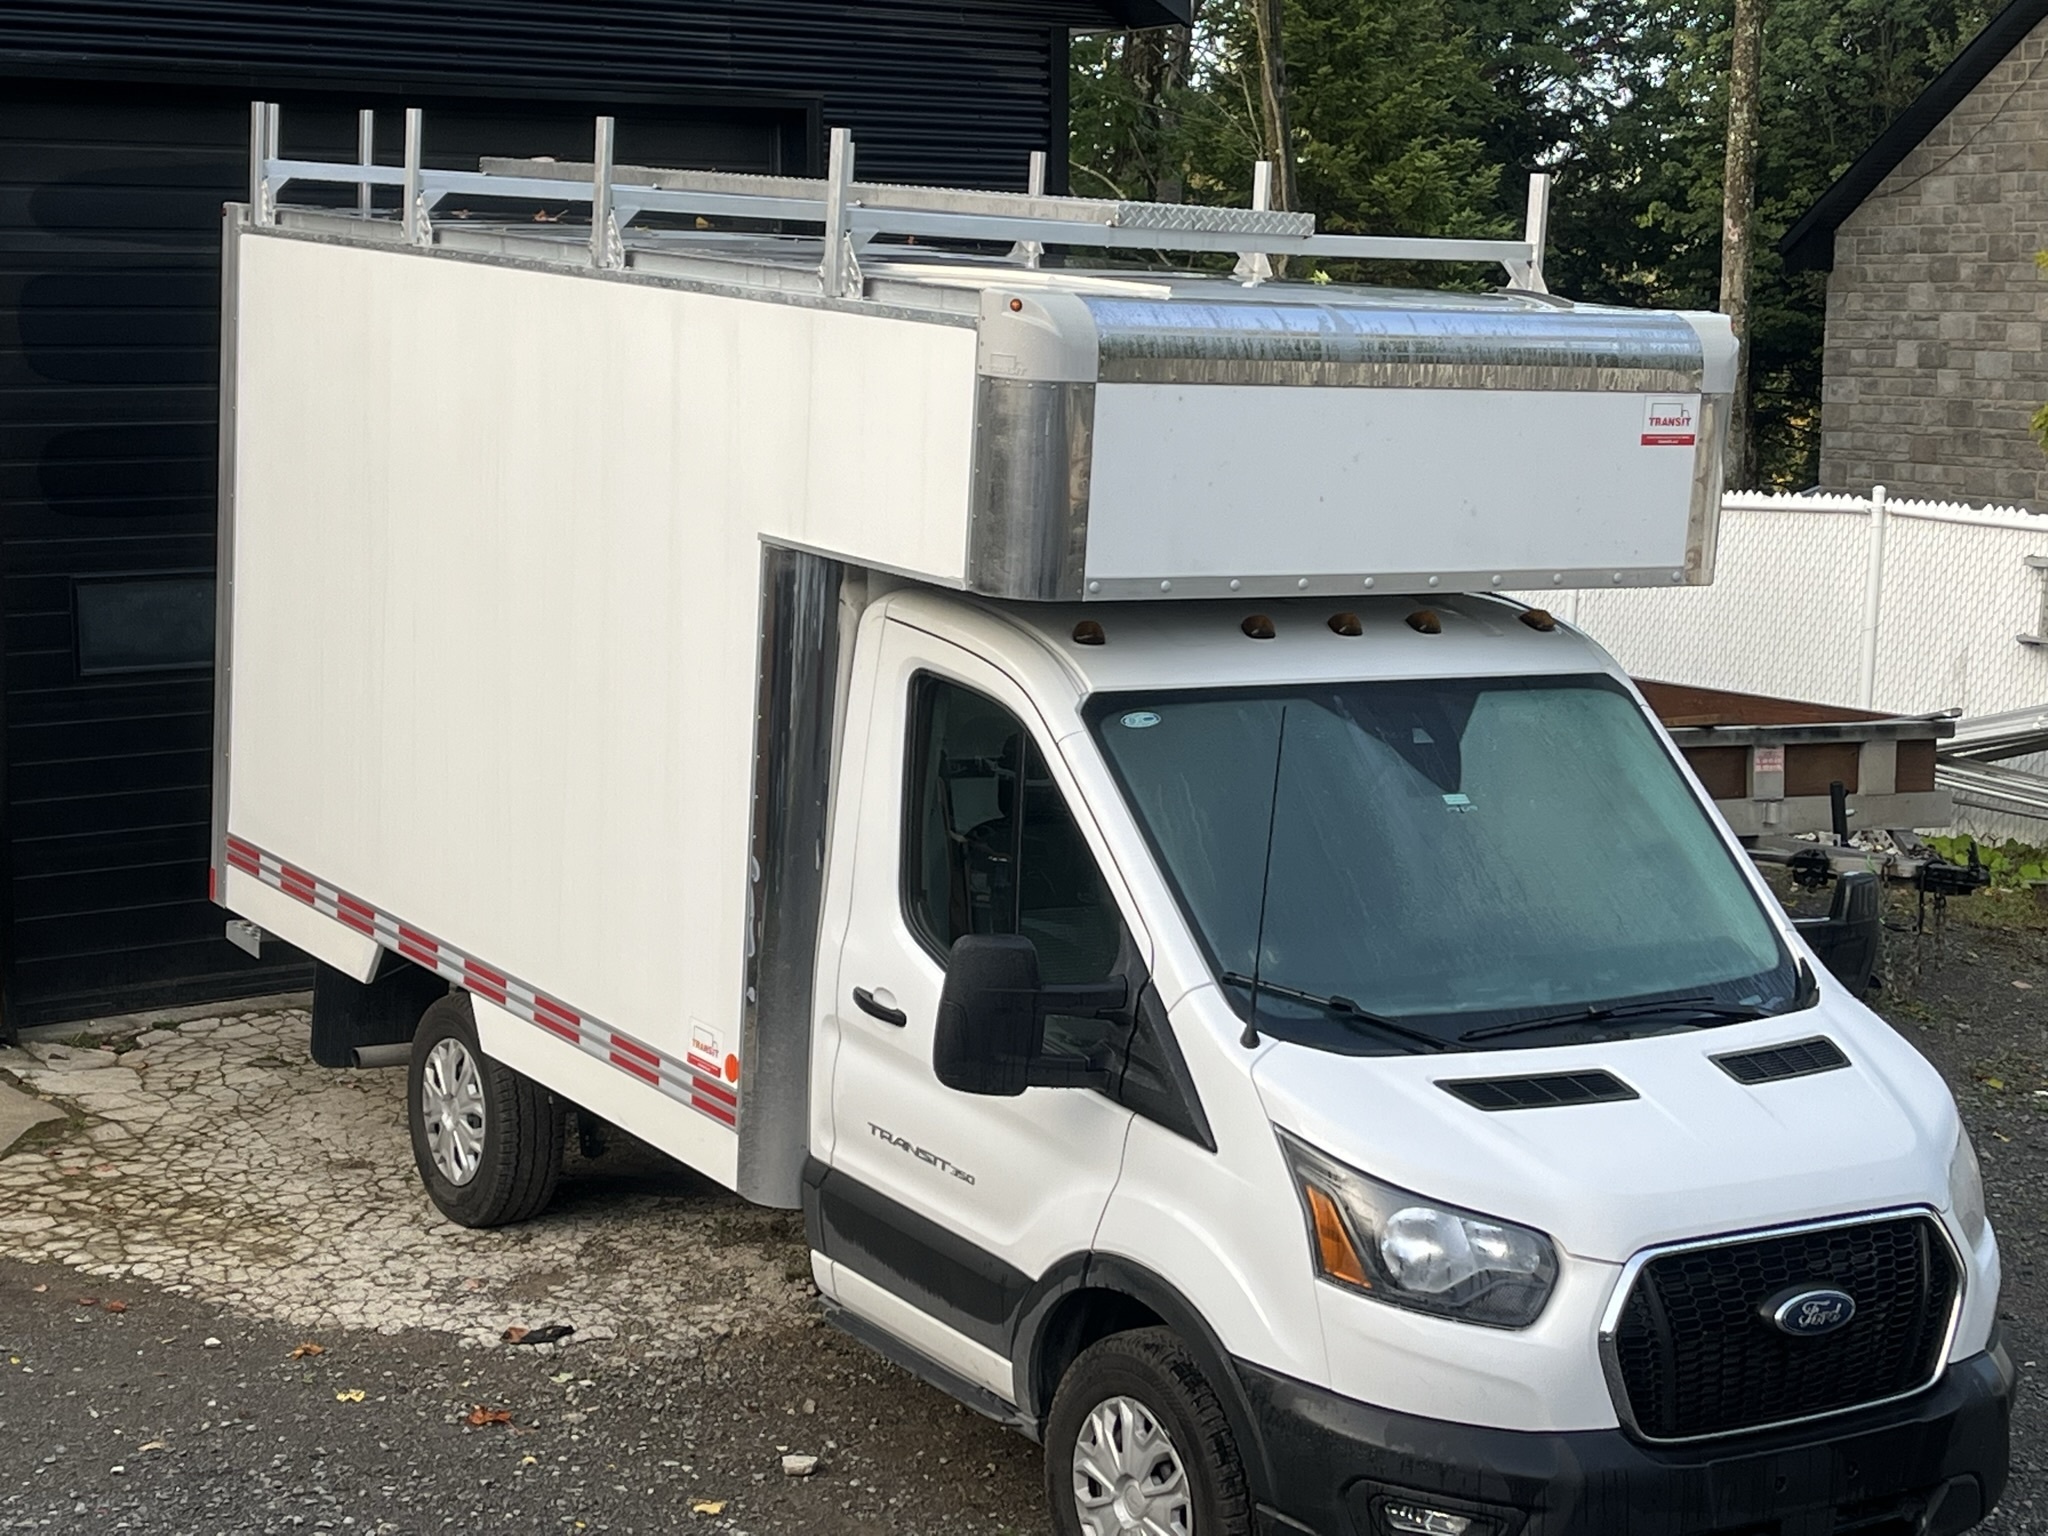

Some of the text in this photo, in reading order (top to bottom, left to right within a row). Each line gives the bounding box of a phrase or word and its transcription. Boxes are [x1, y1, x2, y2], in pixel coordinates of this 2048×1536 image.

[1649, 417, 1692, 427] TRANSIT
[692, 1038, 719, 1058] TRANSIT
[867, 1121, 976, 1186] TRANSIT 350
[1798, 1300, 1842, 1328] Ford
